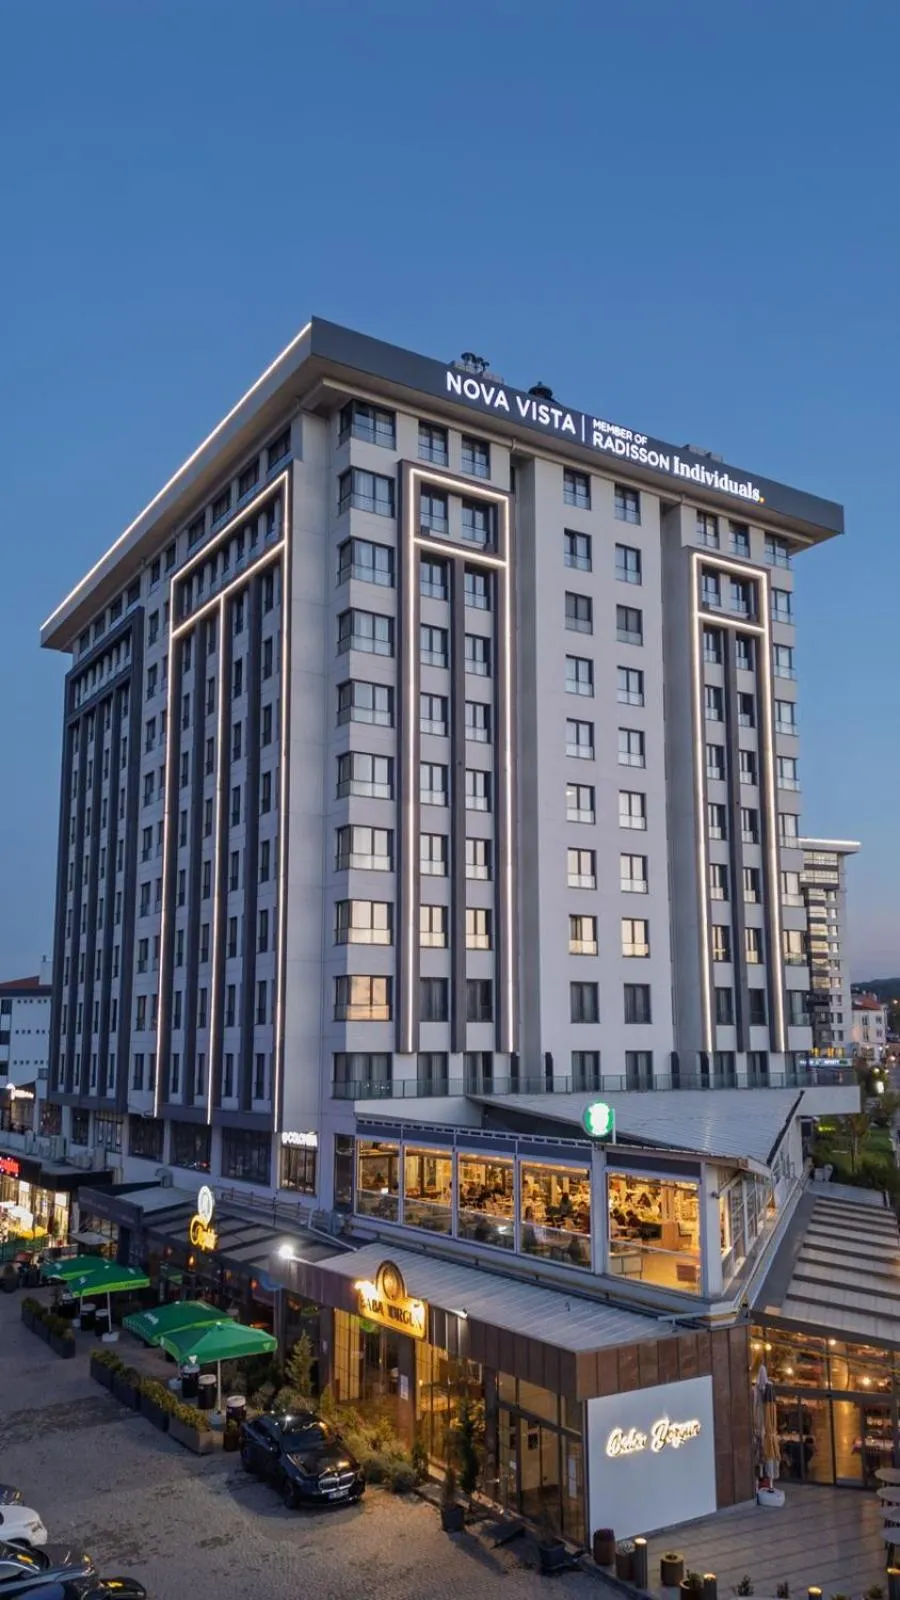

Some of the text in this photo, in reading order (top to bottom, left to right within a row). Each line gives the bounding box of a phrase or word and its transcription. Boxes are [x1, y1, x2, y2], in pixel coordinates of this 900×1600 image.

[446, 371, 577, 435] NOVA VISTA
[592, 418, 648, 446] MEMBER OF
[592, 430, 671, 472] RADISSON
